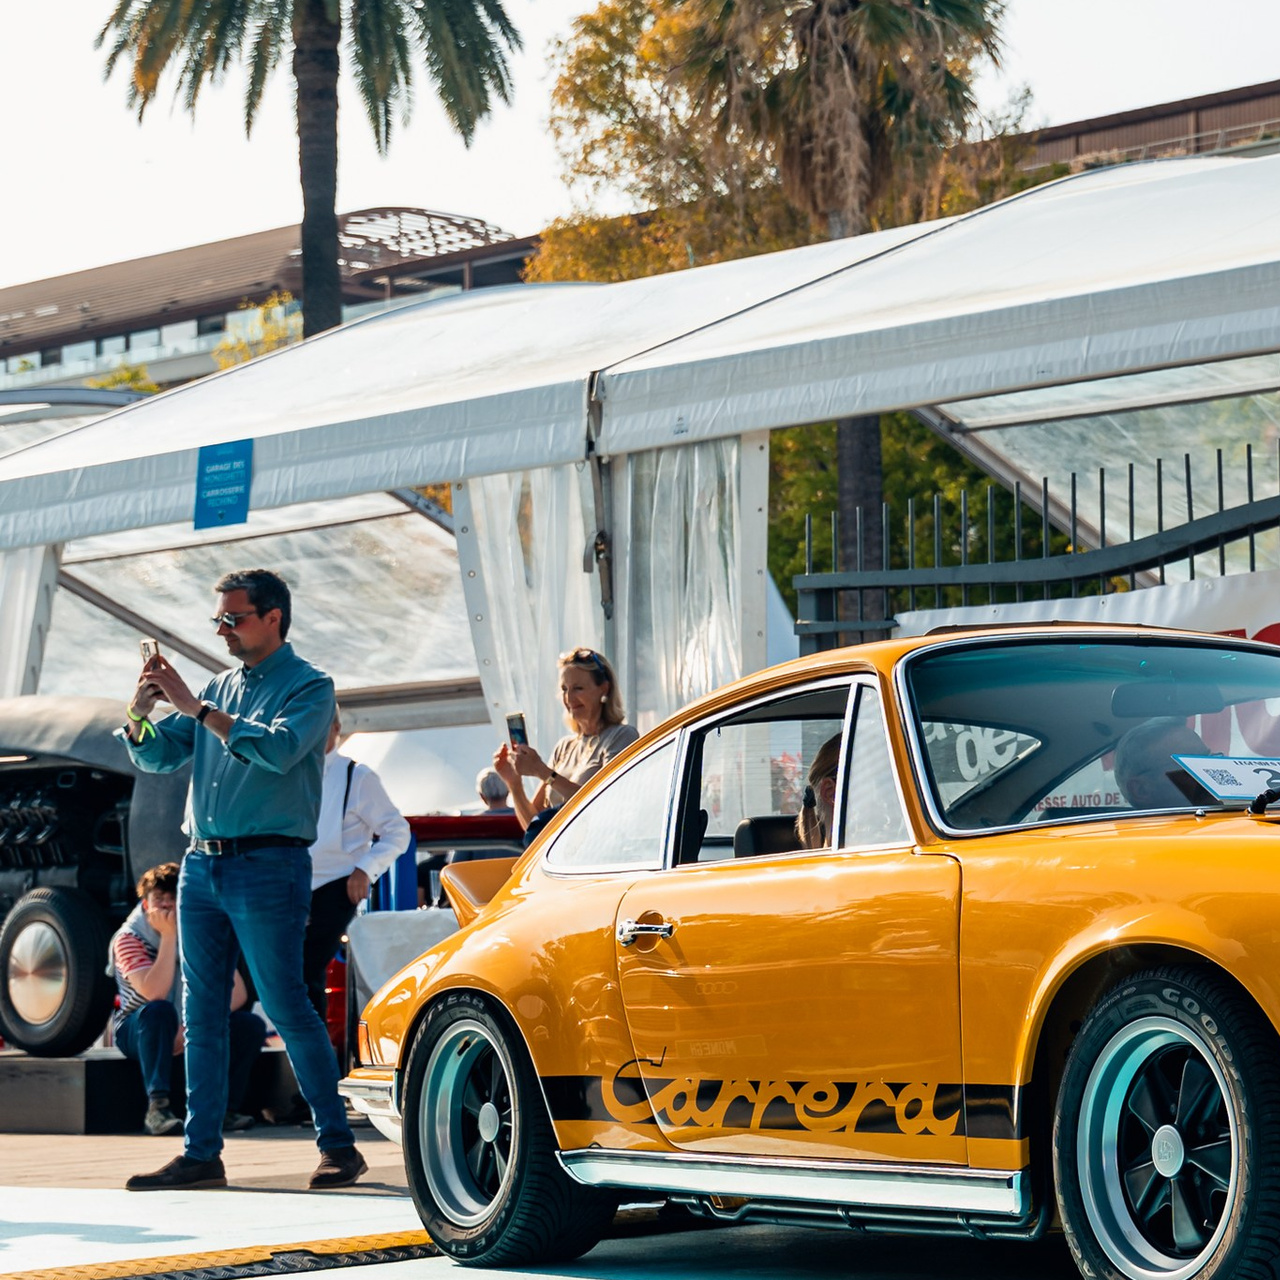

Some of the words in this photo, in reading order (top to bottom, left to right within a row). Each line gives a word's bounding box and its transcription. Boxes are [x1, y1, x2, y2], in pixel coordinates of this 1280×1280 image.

[1033, 795, 1067, 812] ESSE
[1070, 793, 1102, 808] AUTO
[1104, 792, 1120, 806] DE
[601, 1046, 962, 1136] Carrera
